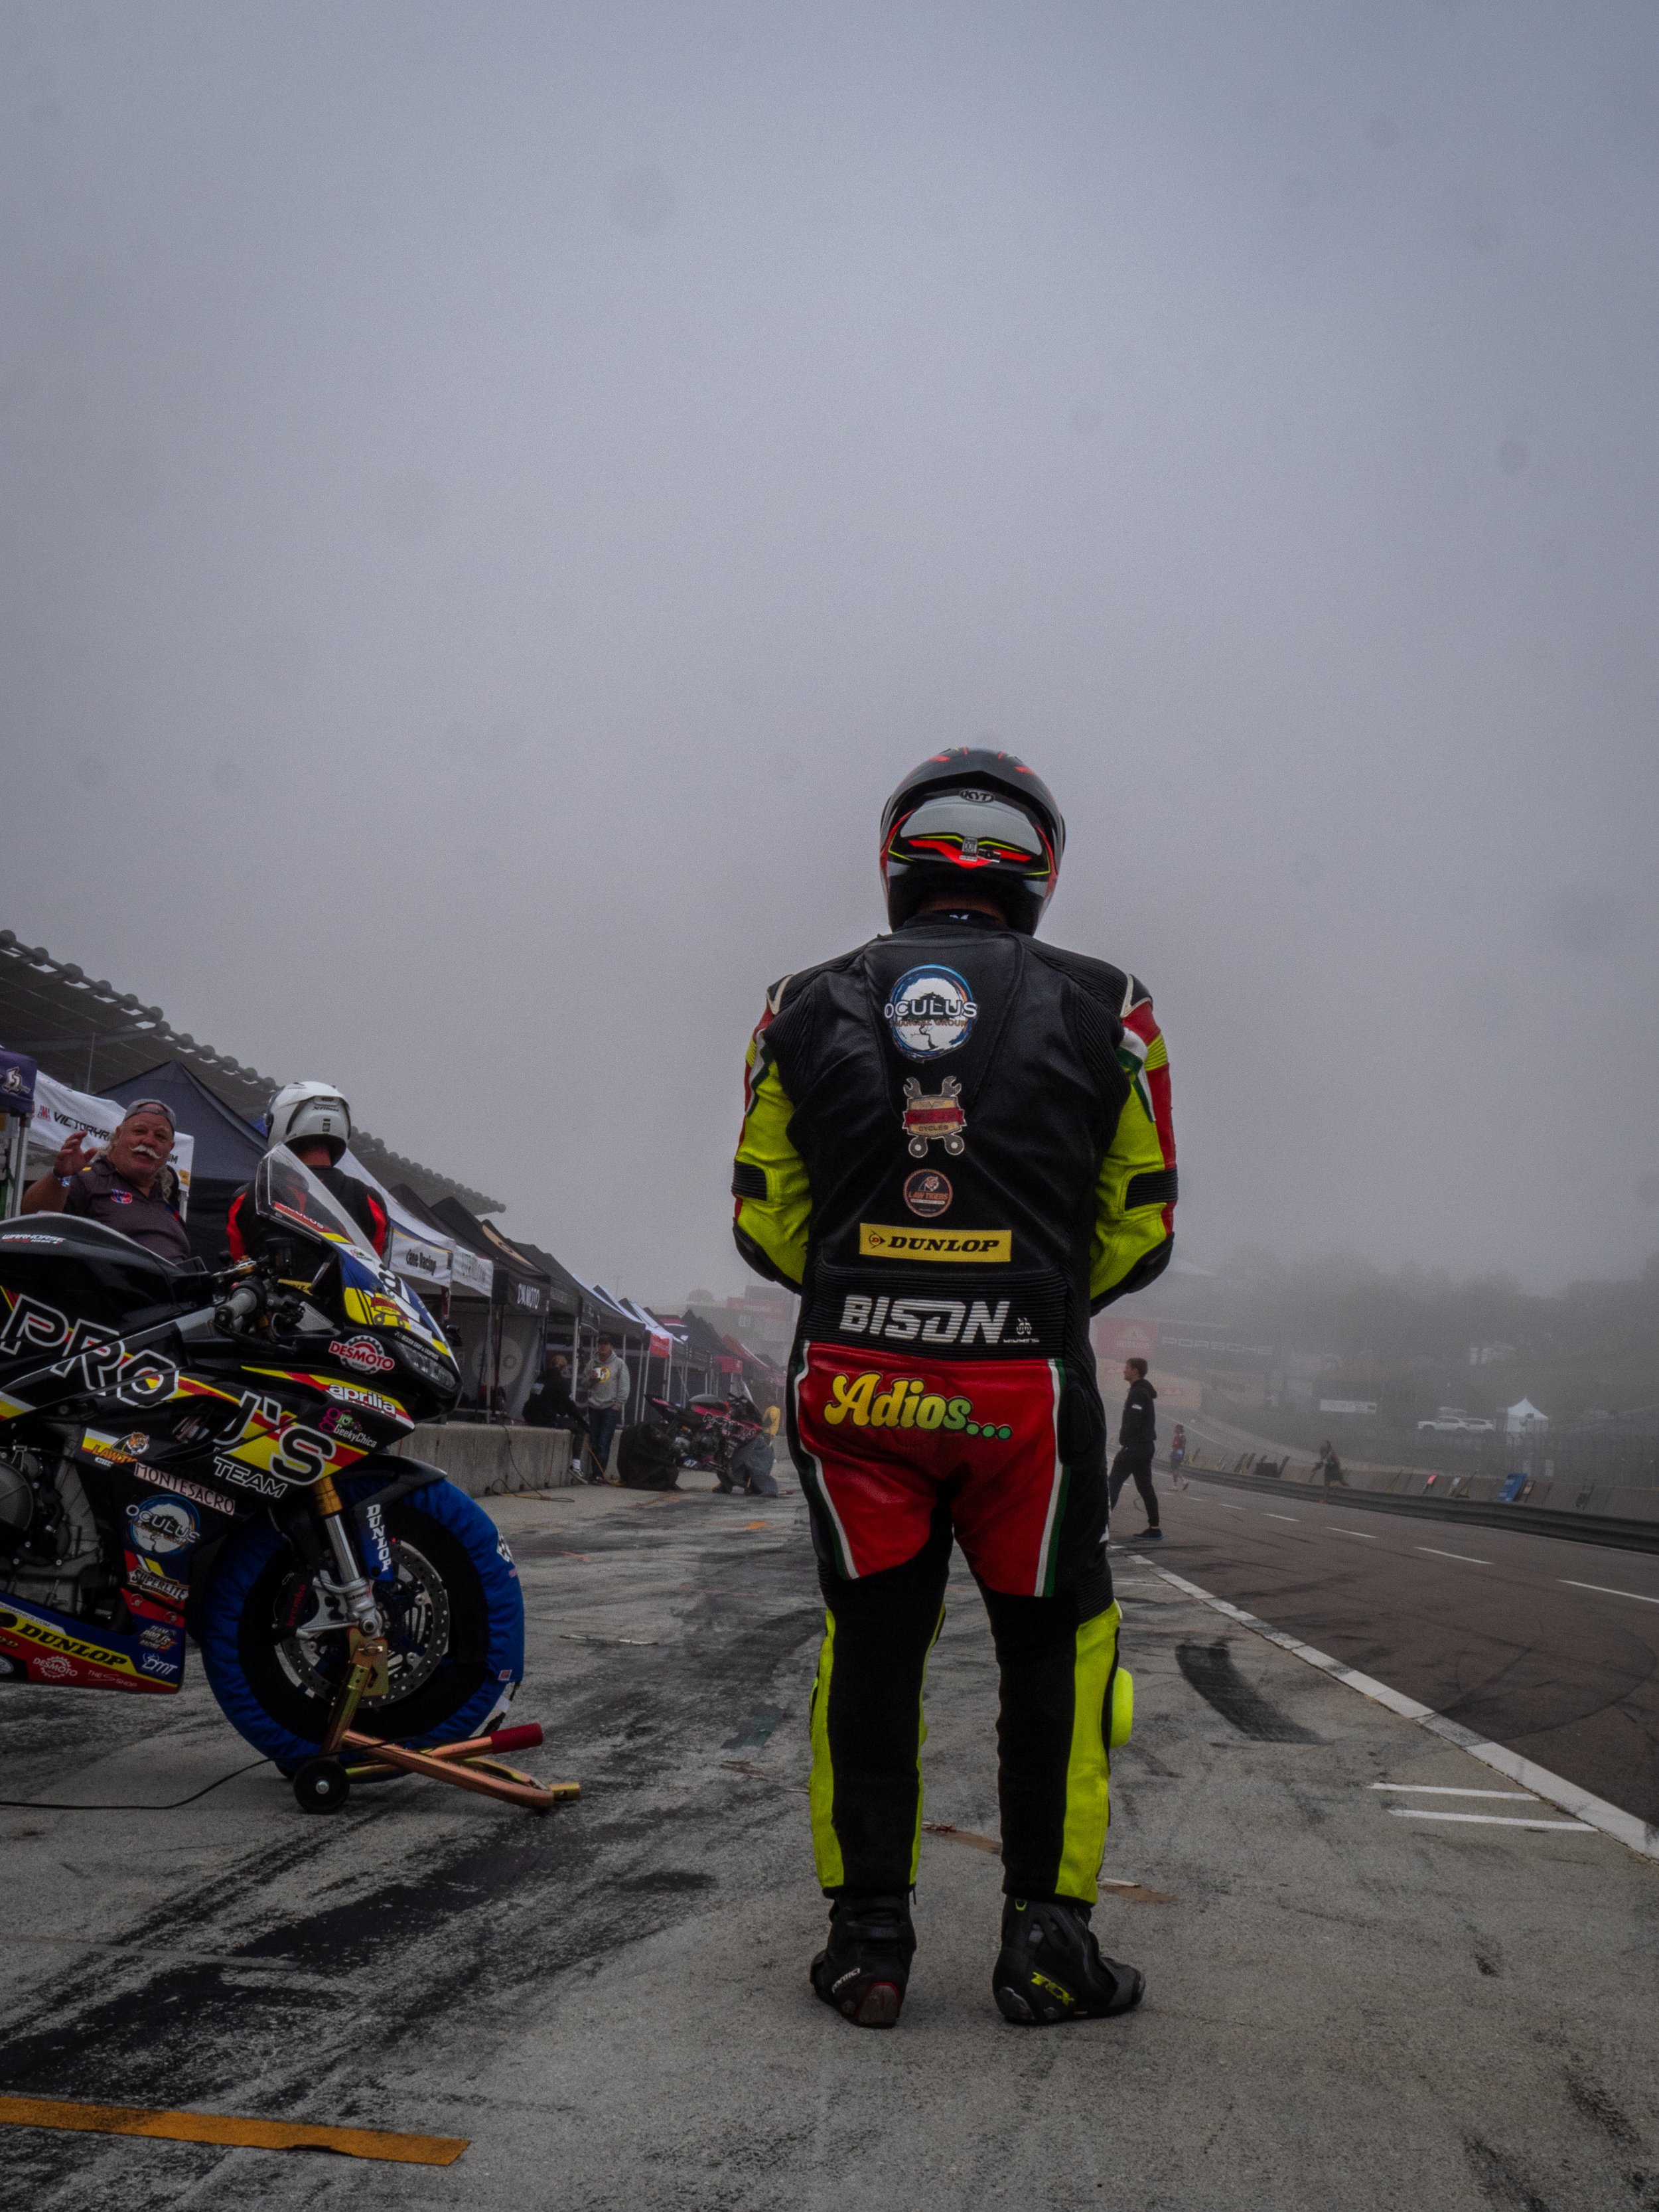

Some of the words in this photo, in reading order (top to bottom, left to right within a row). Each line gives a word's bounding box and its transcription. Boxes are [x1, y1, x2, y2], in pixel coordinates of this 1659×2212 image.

[964, 790, 988, 801] KYT
[884, 999, 977, 1018] OCULUS
[54, 1111, 109, 1141] VICTORYR
[1, 1233, 66, 1242] WARHORSE
[888, 1236, 999, 1252] DUNLOP
[839, 1294, 1011, 1344] BISON
[0, 1293, 180, 1409] PRO
[330, 1341, 394, 1370] DESMOTO
[1162, 1336, 1273, 1356] PORSCHE
[328, 1384, 396, 1415] aprilia
[824, 1370, 1013, 1440] Adios...
[333, 1424, 378, 1448] GeekyChica
[135, 1462, 234, 1514] MONTESACRO
[212, 1455, 288, 1499] TEAM
[125, 1505, 200, 1543] OCULUS
[366, 1503, 392, 1572] DUNLOP
[133, 1569, 188, 1601] SUPERLITE
[286, 1584, 307, 1628] brembo
[18, 1623, 128, 1666] DUNLOP
[33, 1657, 78, 1677] DESMOTO
[88, 1669, 103, 1678] THE
[115, 1678, 137, 1688] SHOP
